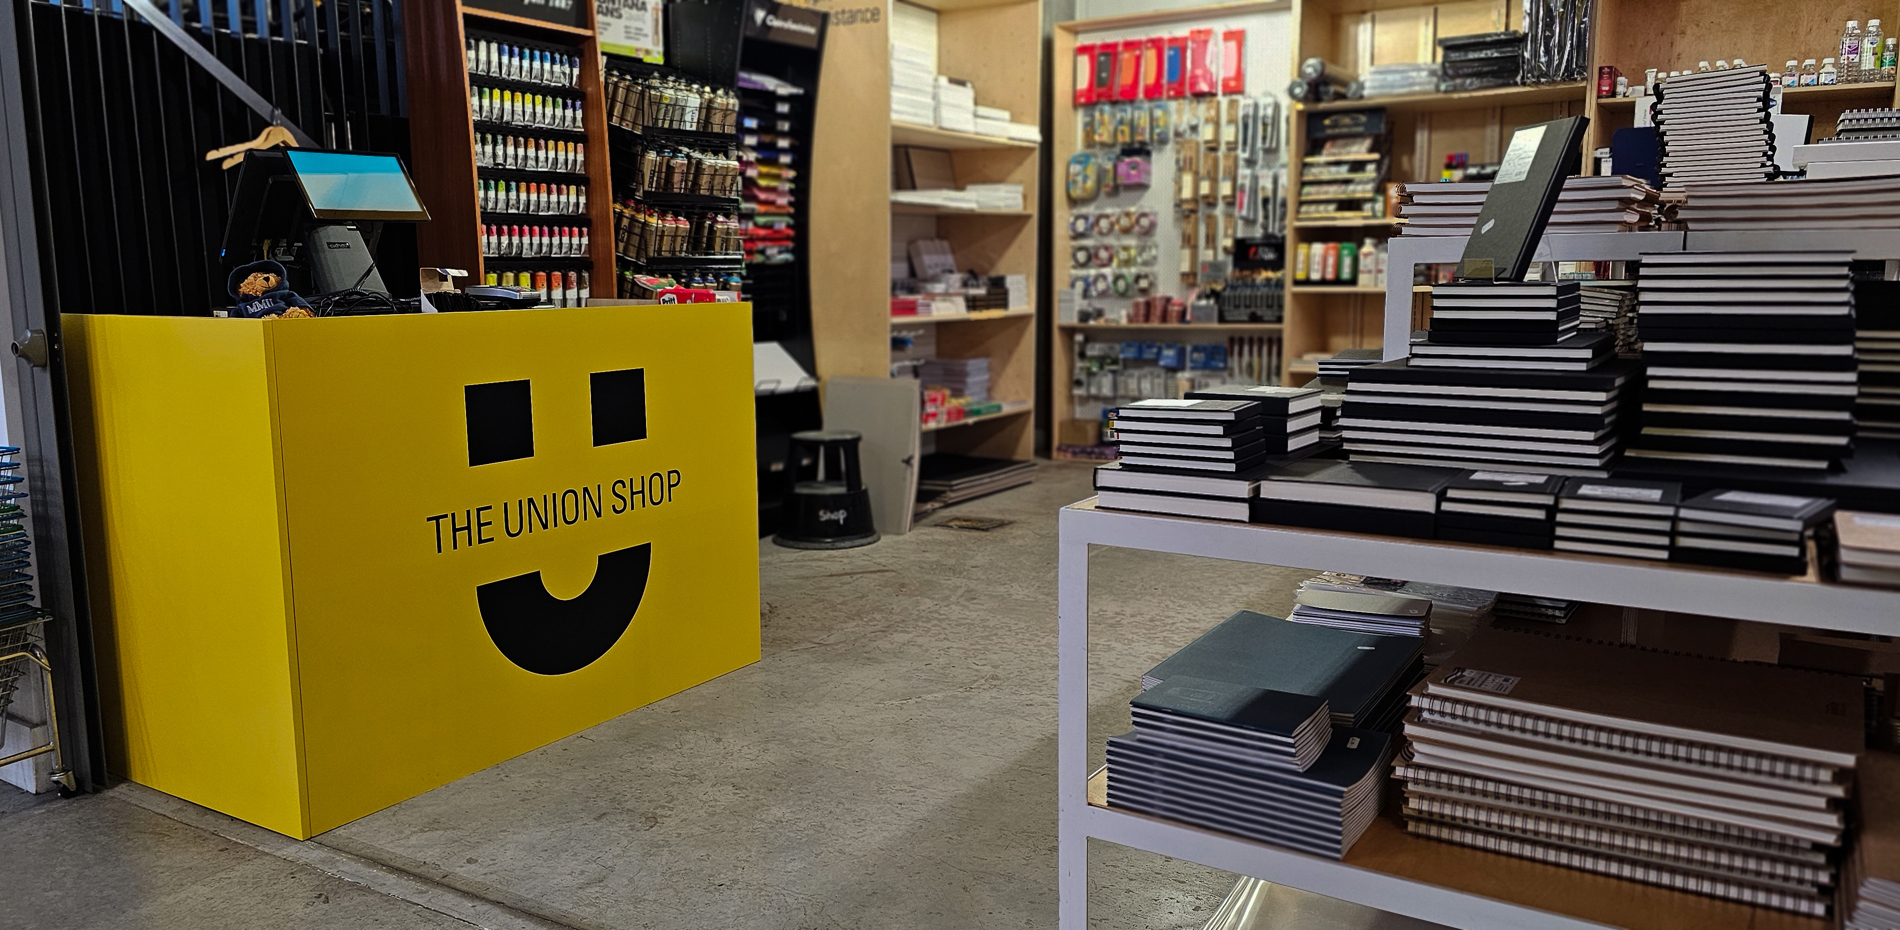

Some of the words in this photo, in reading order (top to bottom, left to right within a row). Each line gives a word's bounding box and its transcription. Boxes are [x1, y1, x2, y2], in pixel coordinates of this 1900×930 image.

[246, 298, 274, 314] MMU
[426, 504, 495, 554] THE
[503, 483, 603, 538] UNION
[611, 469, 681, 515] SHOP
[819, 510, 847, 525] Shop
